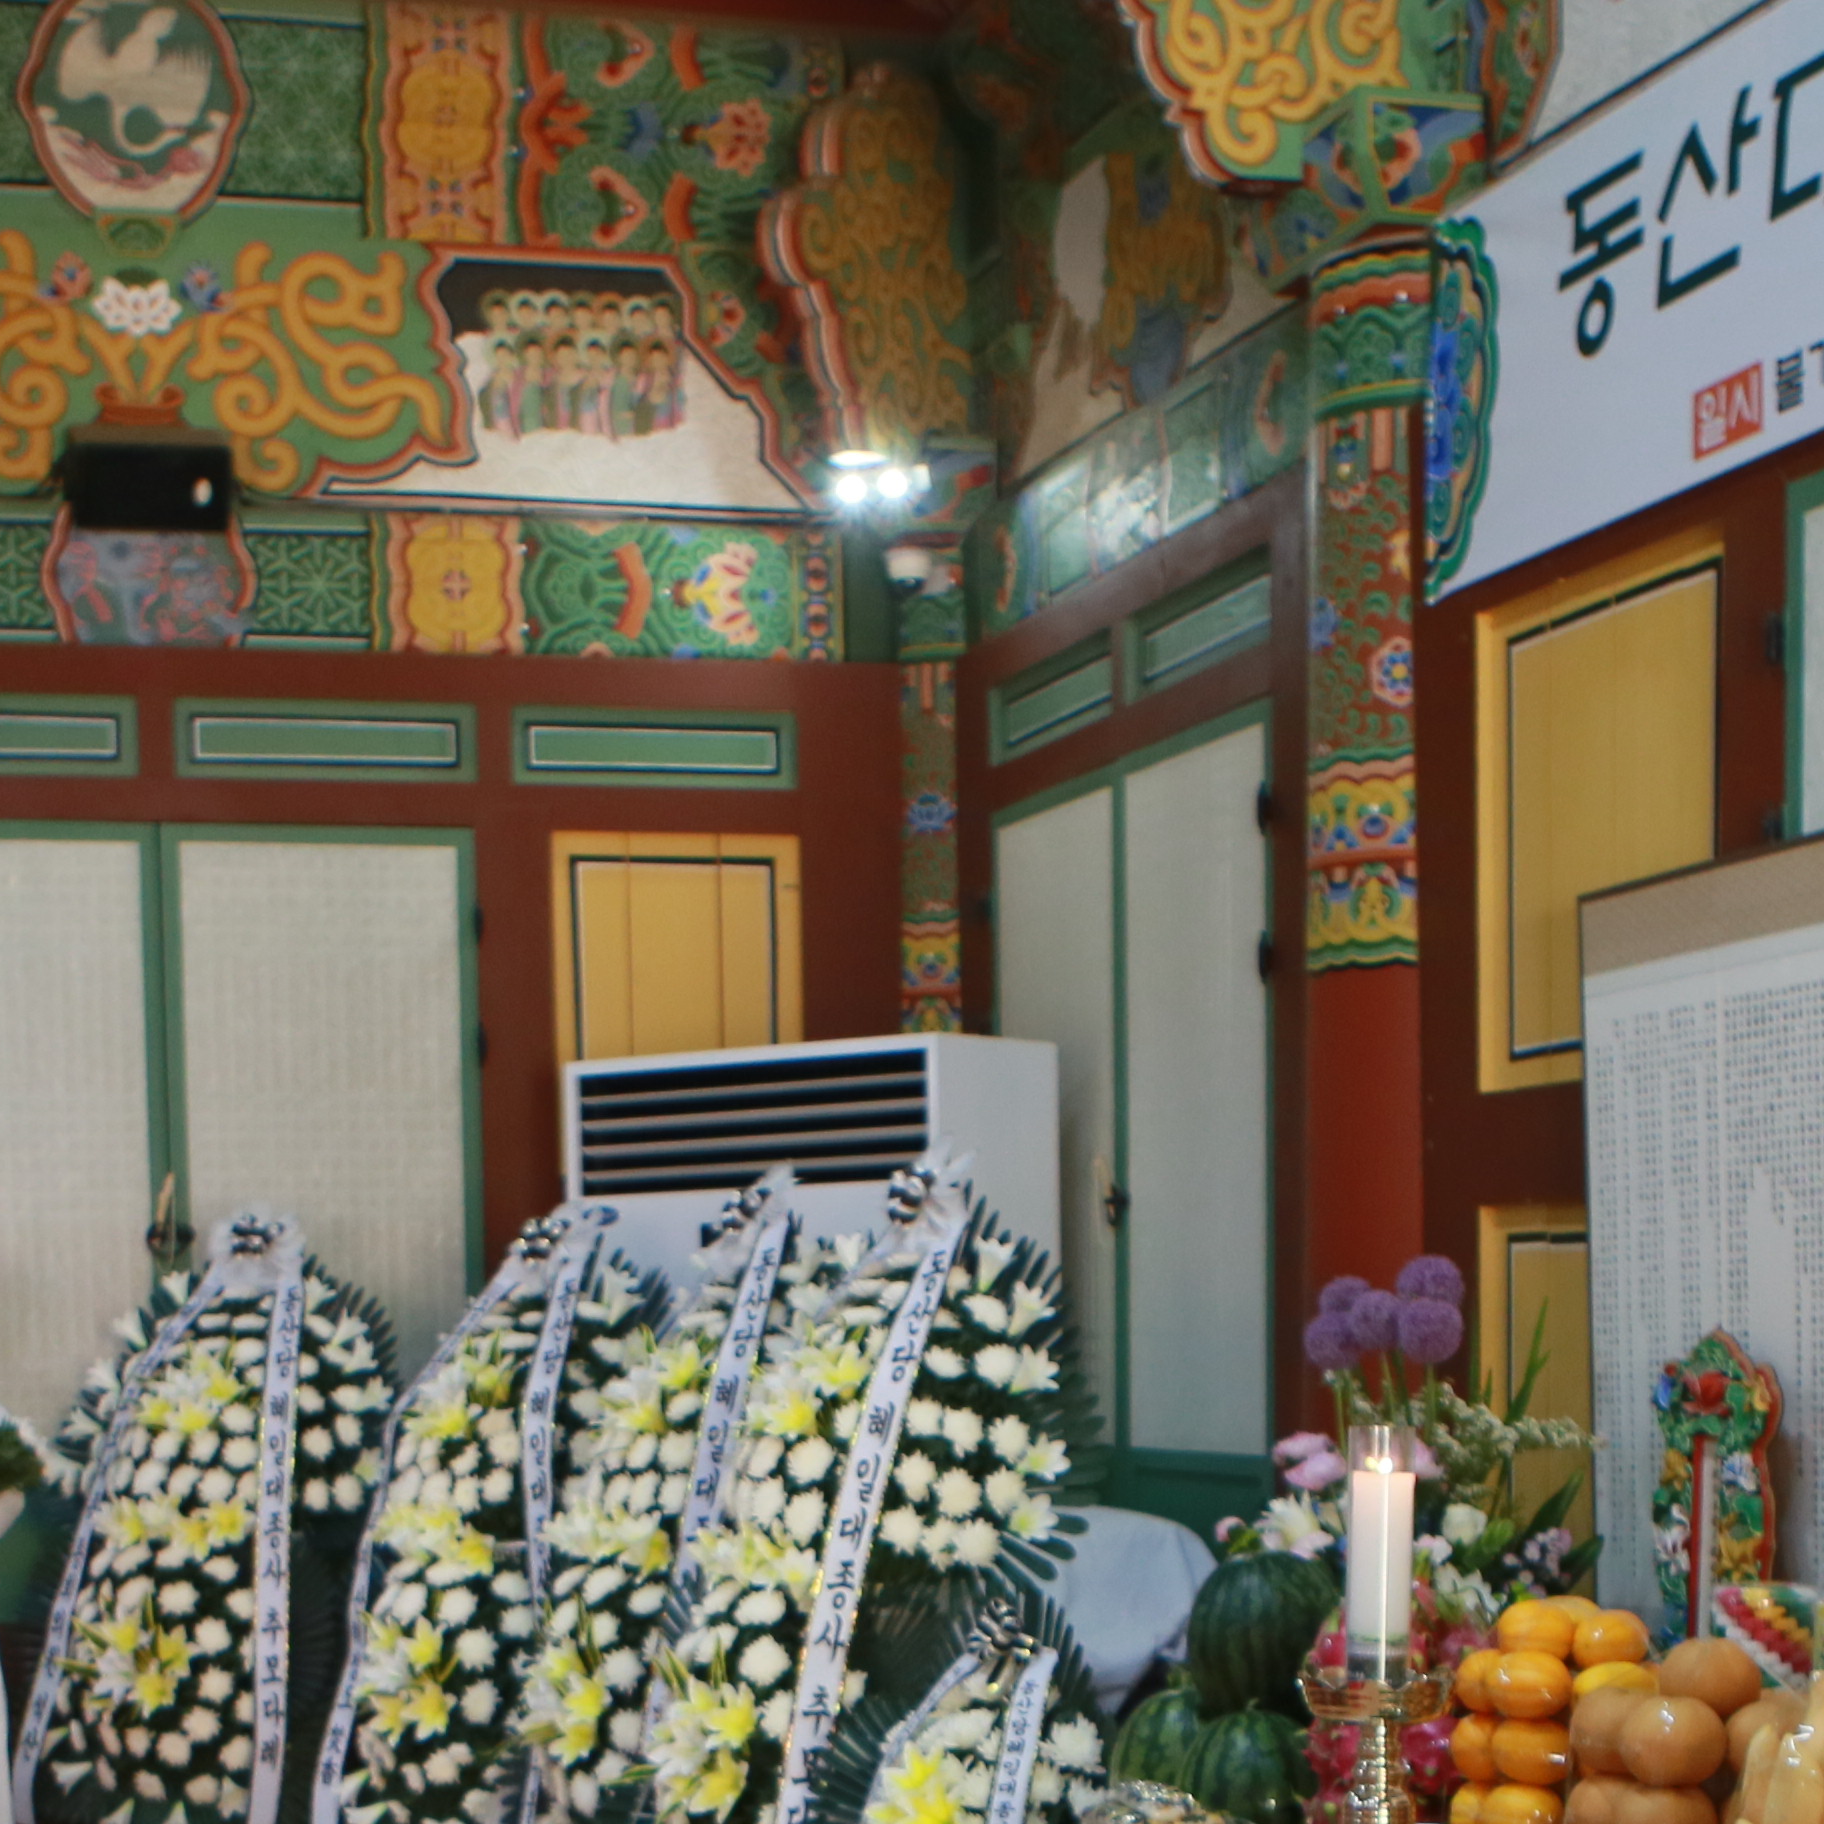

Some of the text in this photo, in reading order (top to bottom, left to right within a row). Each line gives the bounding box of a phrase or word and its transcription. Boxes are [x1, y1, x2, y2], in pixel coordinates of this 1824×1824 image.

[1695, 372, 1762, 451] 일시
[730, 1248, 776, 1358] 동산당
[890, 1249, 948, 1384] 동산당
[816, 1400, 896, 1663] 혜일대종사
[258, 1605, 287, 1768] 추모다례
